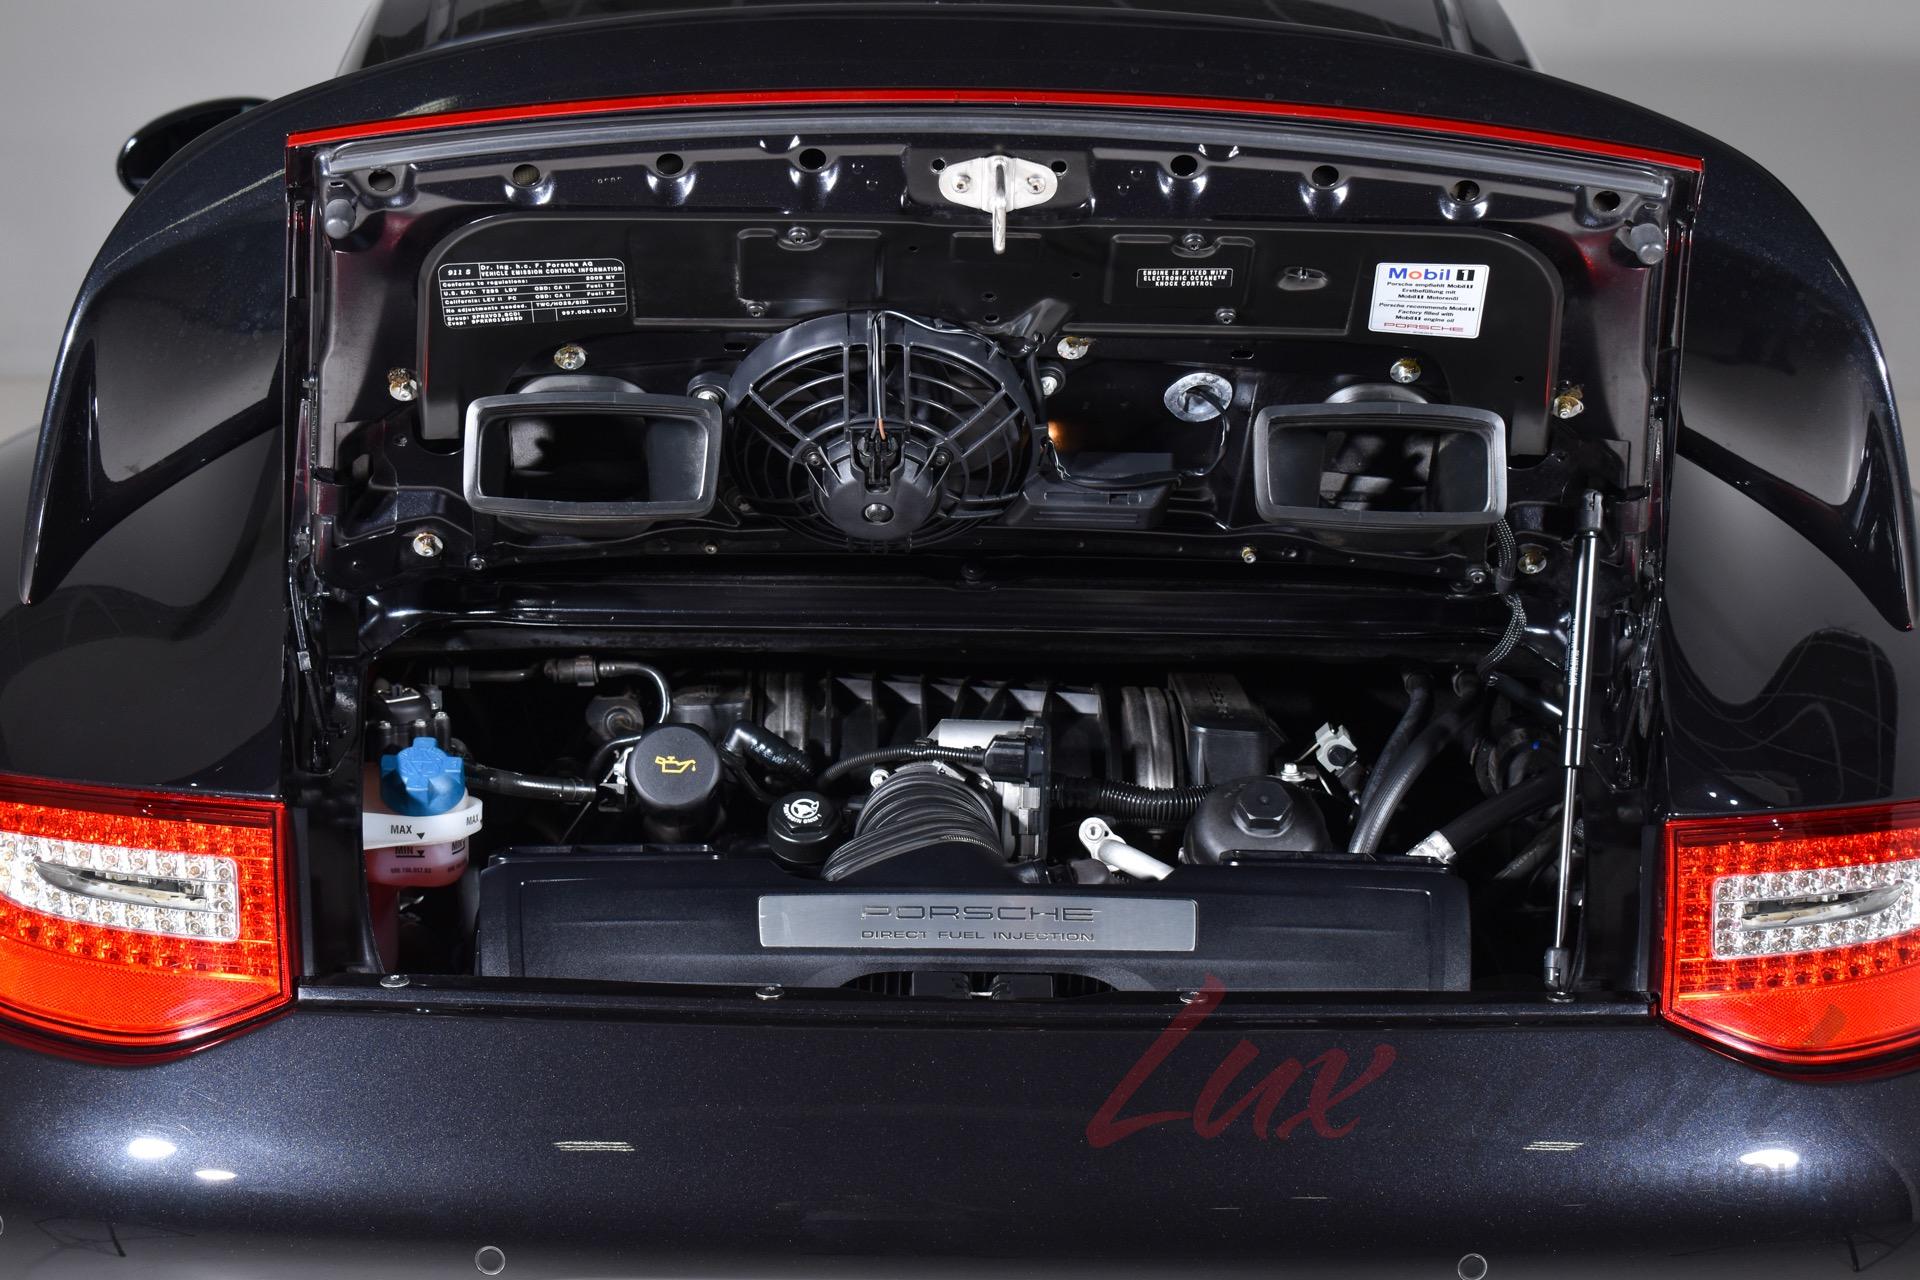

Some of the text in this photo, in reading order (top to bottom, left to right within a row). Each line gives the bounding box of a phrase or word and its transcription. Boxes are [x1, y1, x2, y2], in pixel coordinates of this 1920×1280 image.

[480, 269, 508, 277] VEHICLE
[511, 268, 543, 276] EMISSION
[1388, 267, 1451, 280] Mobil
[457, 305, 498, 313] adjustments
[1384, 322, 1463, 332] PORSCHE
[466, 814, 479, 826] MAX
[390, 825, 412, 834] MAX
[395, 846, 414, 855] MIN
[861, 905, 1094, 921] PORSCHE
[861, 930, 1094, 942] DIRECT FUEL INJECTION
